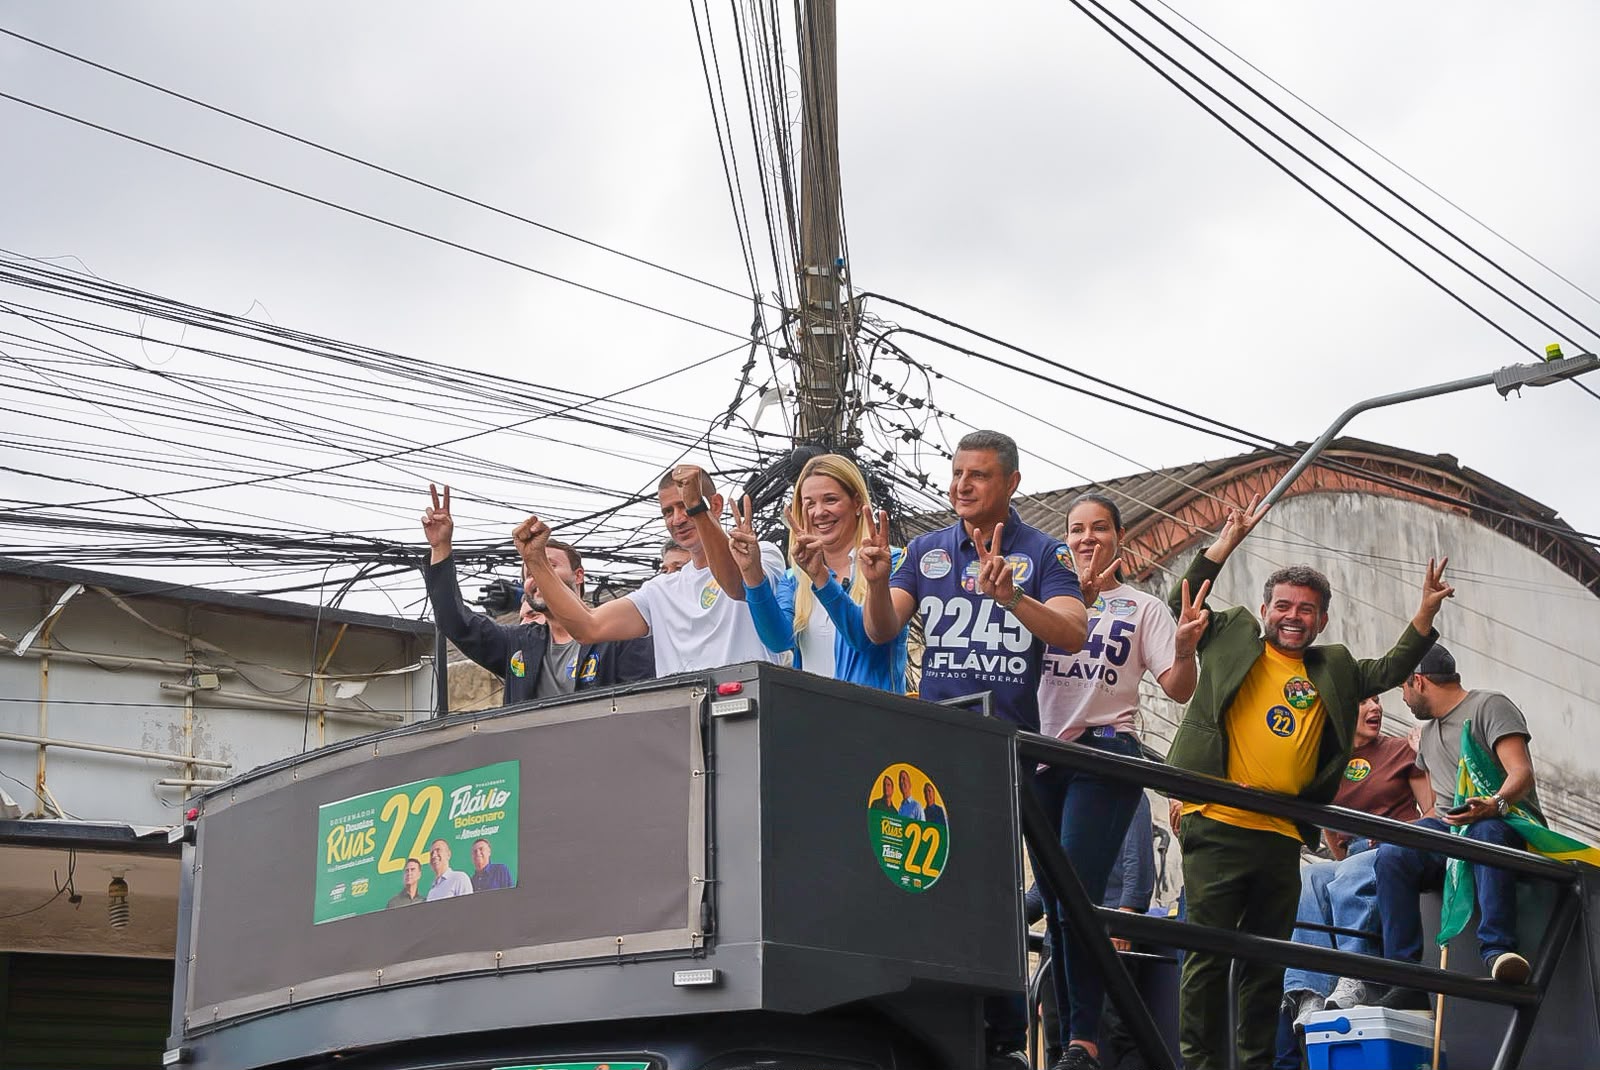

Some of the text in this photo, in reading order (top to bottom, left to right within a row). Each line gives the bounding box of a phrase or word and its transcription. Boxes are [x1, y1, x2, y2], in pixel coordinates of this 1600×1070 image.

[920, 596, 1033, 653] 2245
[934, 649, 1027, 675] FLÁVIO
[1043, 658, 1118, 686] FLÁVIO
[975, 674, 1025, 685] FEDERAL
[1272, 714, 1291, 734] 22
[449, 784, 511, 820] Flávio
[377, 785, 444, 875] 22
[454, 811, 505, 829] Bolsonaro
[905, 822, 940, 878] 22
